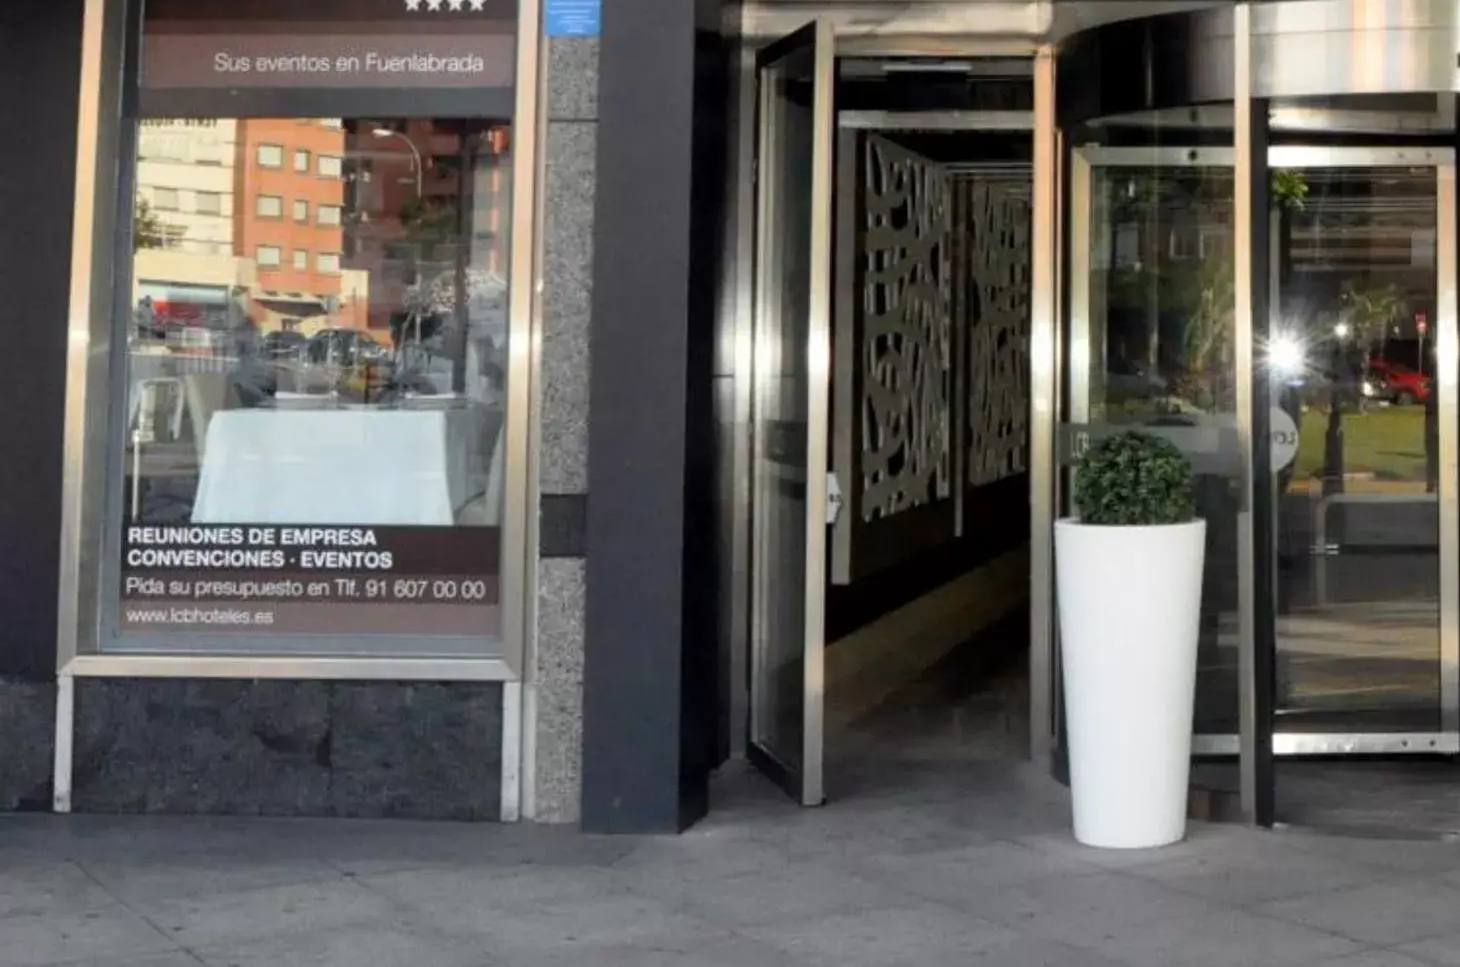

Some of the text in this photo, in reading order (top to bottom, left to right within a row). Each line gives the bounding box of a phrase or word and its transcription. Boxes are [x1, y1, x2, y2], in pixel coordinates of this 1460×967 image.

[213, 52, 484, 73] Sus eventos en Fuenlabrada
[127, 527, 377, 545] REUNIONES DE EMPRESA
[127, 550, 393, 568] CONVENCIONES EVENTOS
[126, 577, 164, 595] Pida
[169, 582, 190, 595] su
[195, 580, 304, 598] presupuesto
[307, 582, 330, 596] en
[365, 580, 386, 597] 91
[394, 580, 426, 598] 607
[432, 581, 457, 598] 00
[461, 581, 486, 599] 00
[127, 607, 274, 624] www.lcbhoteles.es
